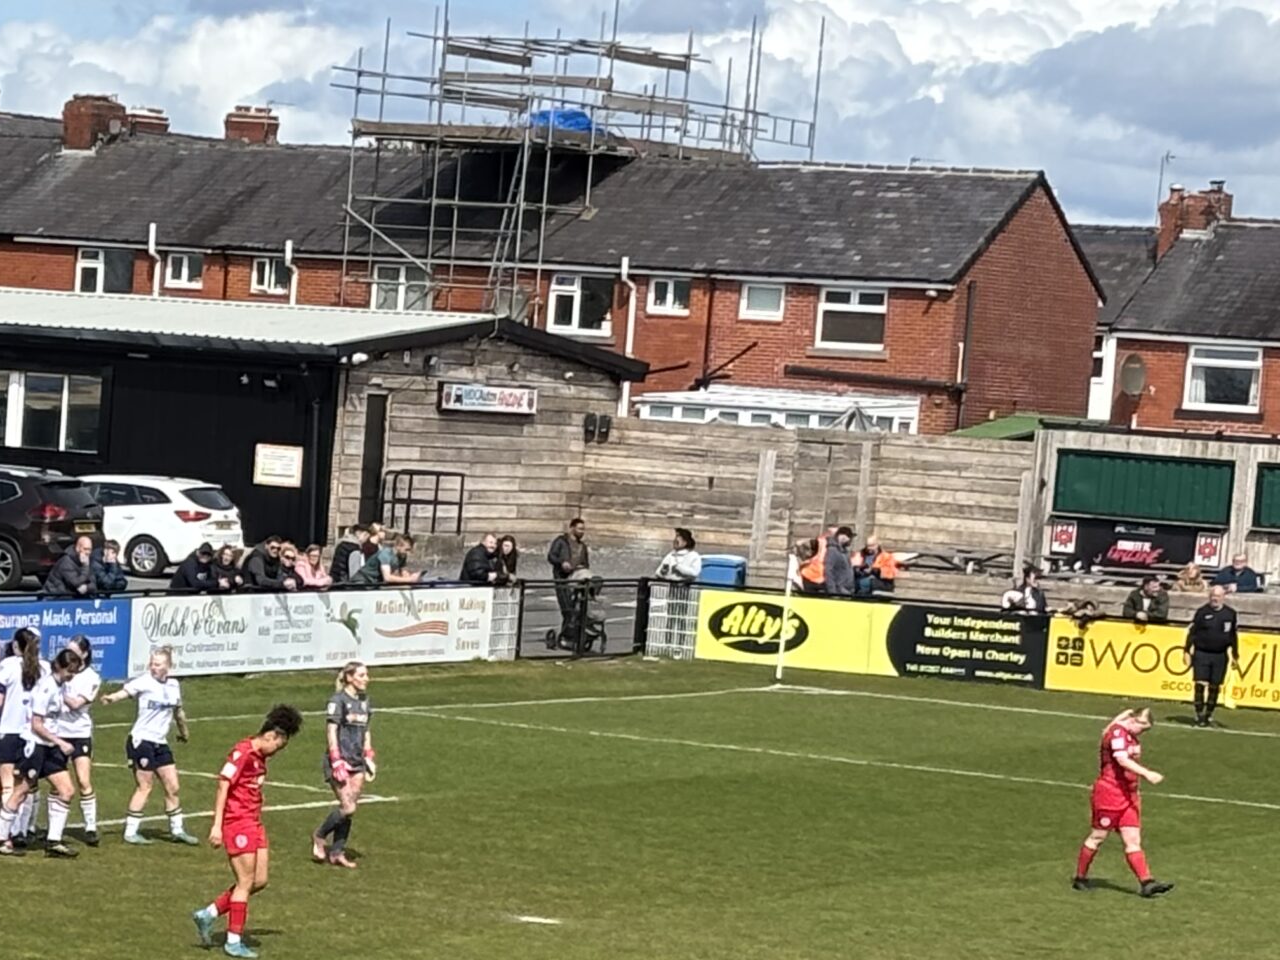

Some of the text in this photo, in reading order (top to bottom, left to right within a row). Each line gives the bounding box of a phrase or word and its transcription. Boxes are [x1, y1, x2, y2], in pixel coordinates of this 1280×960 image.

[457, 598, 487, 614] Making
[42, 607, 73, 628] Made,
[74, 605, 118, 626] Personal
[457, 617, 481, 630] Great
[926, 614, 1021, 631] Your Independent
[924, 627, 1021, 645] Builders Merchant
[942, 647, 971, 660] Open
[972, 649, 983, 659] in
[985, 650, 1027, 665] Chorley
[1250, 685, 1269, 699] for
